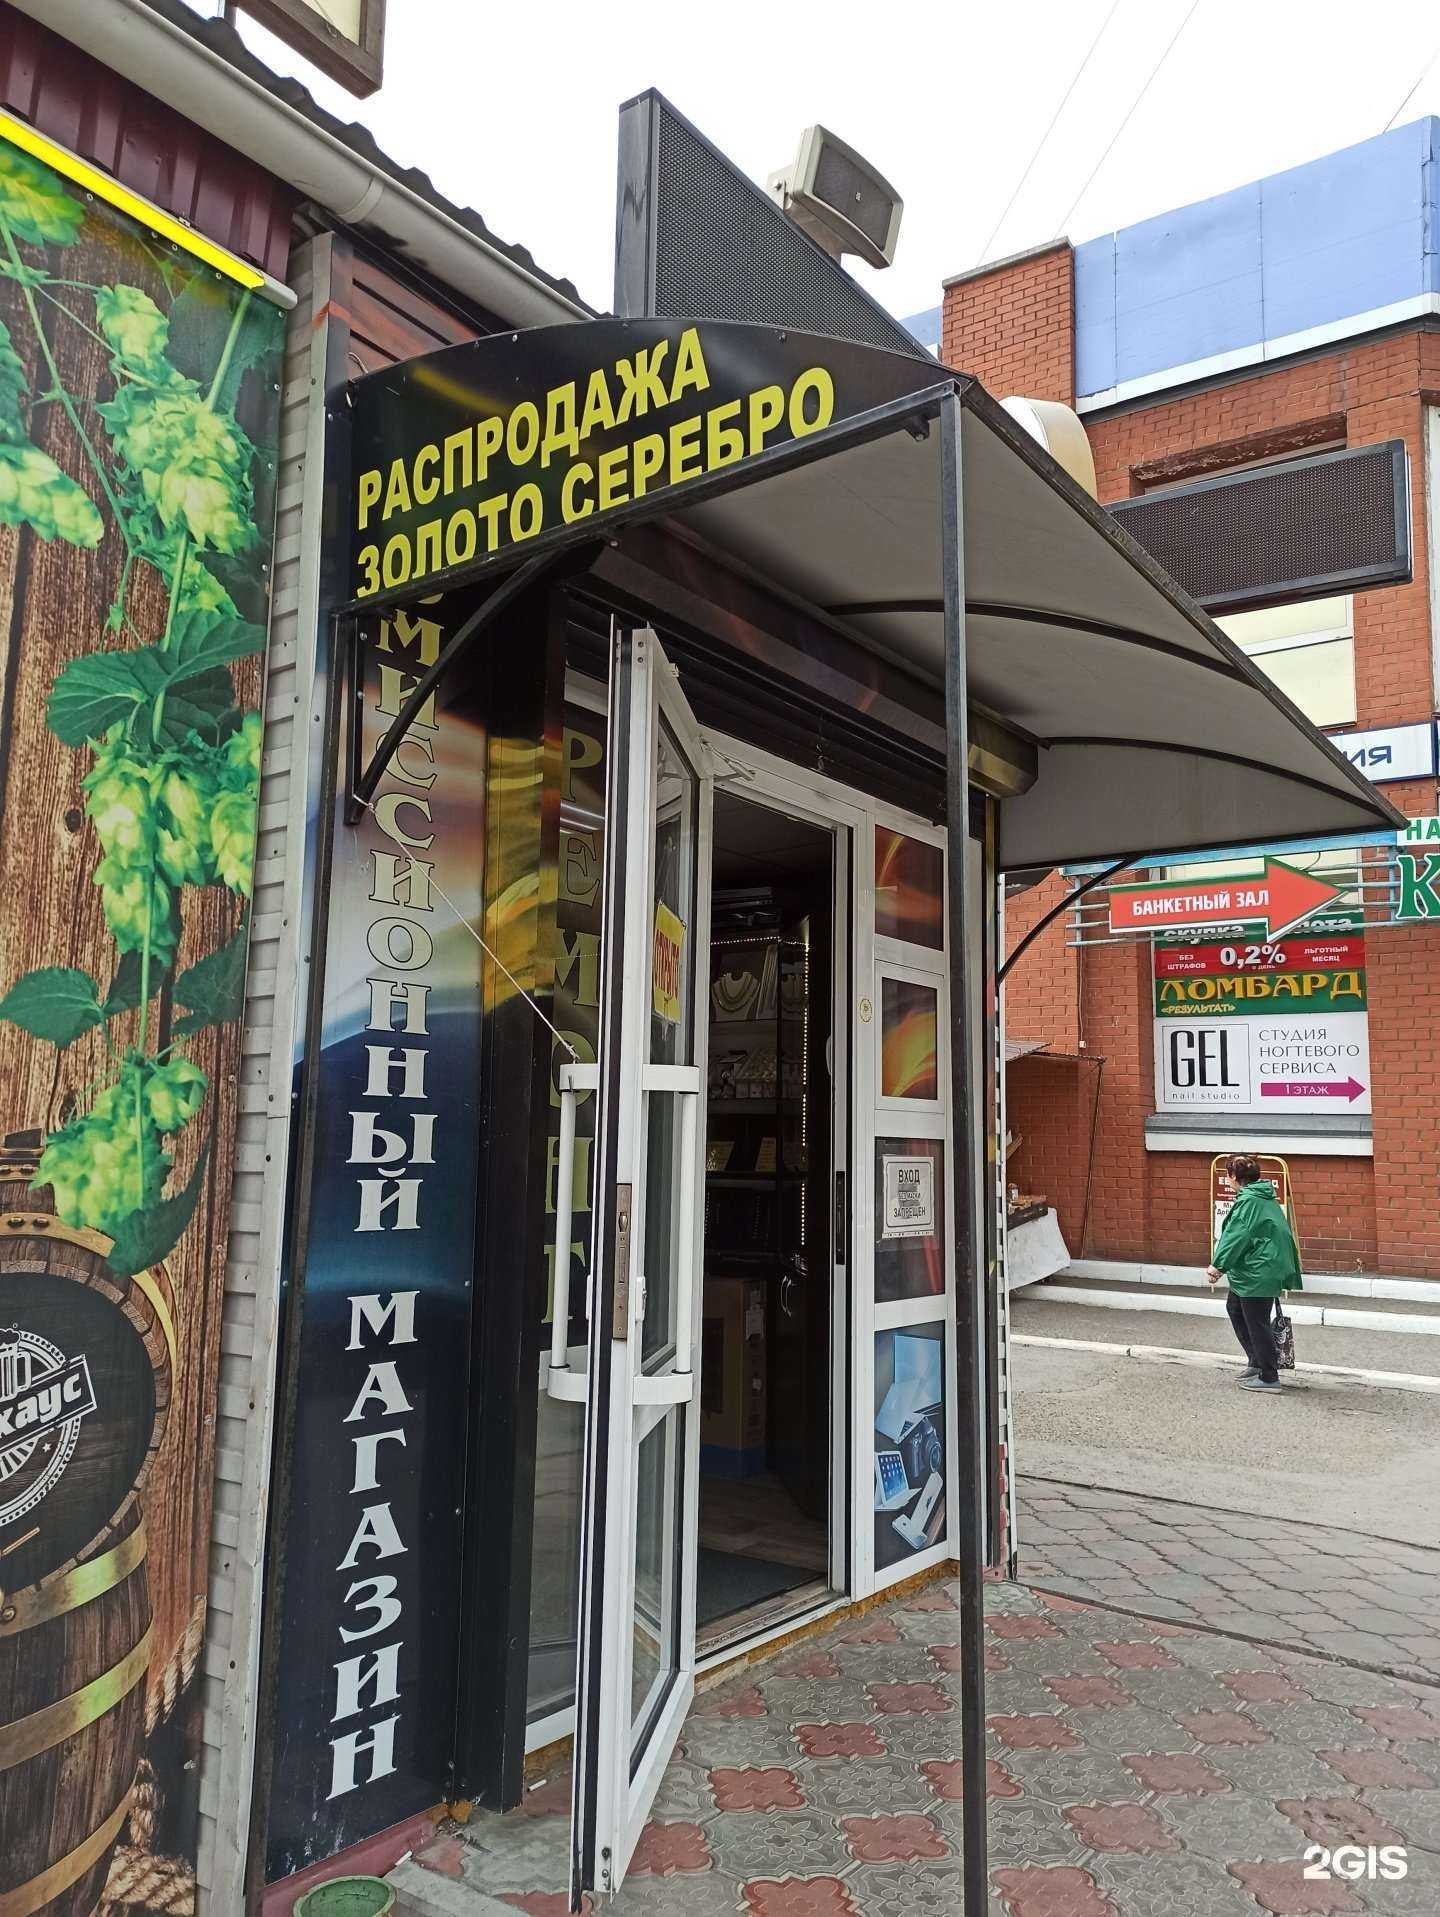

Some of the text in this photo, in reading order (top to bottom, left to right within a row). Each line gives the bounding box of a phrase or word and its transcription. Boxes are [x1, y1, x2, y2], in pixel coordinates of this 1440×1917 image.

[358, 327, 711, 530] РАСПРОДАЖА
[356, 366, 836, 598] ЗОЛОТО СЕРЕБРО
[1133, 890, 1269, 916] БАНКЕТНЫЙ ЗАЛ
[1304, 945, 1349, 954] ЛЬГОТНЫЙ
[1220, 944, 1287, 969] 0,2%
[1312, 955, 1341, 963] МЕСЯЦ
[1167, 962, 1207, 970] ШТРАФОВ
[1160, 972, 1362, 1001] ЛОМБАРД
[1161, 1003, 1237, 1015] «РЕЗУЛЬТАТ»
[1259, 1028, 1328, 1042] СТУДИЯ
[1259, 1044, 1360, 1057] НОГТЕВОГО
[1171, 1029, 1240, 1087] GEL
[1259, 1062, 1337, 1075] СЕРВИСА
[1172, 1091, 1240, 1100] nail studio
[1294, 1085, 1329, 1095] ЭТАЖ
[898, 1169, 921, 1184] ВХОД
[326, 592, 445, 1801] МИССИОННЫЙ МАГАЗИН
[893, 1206, 926, 1219] ЗАПРЕЩЕН
